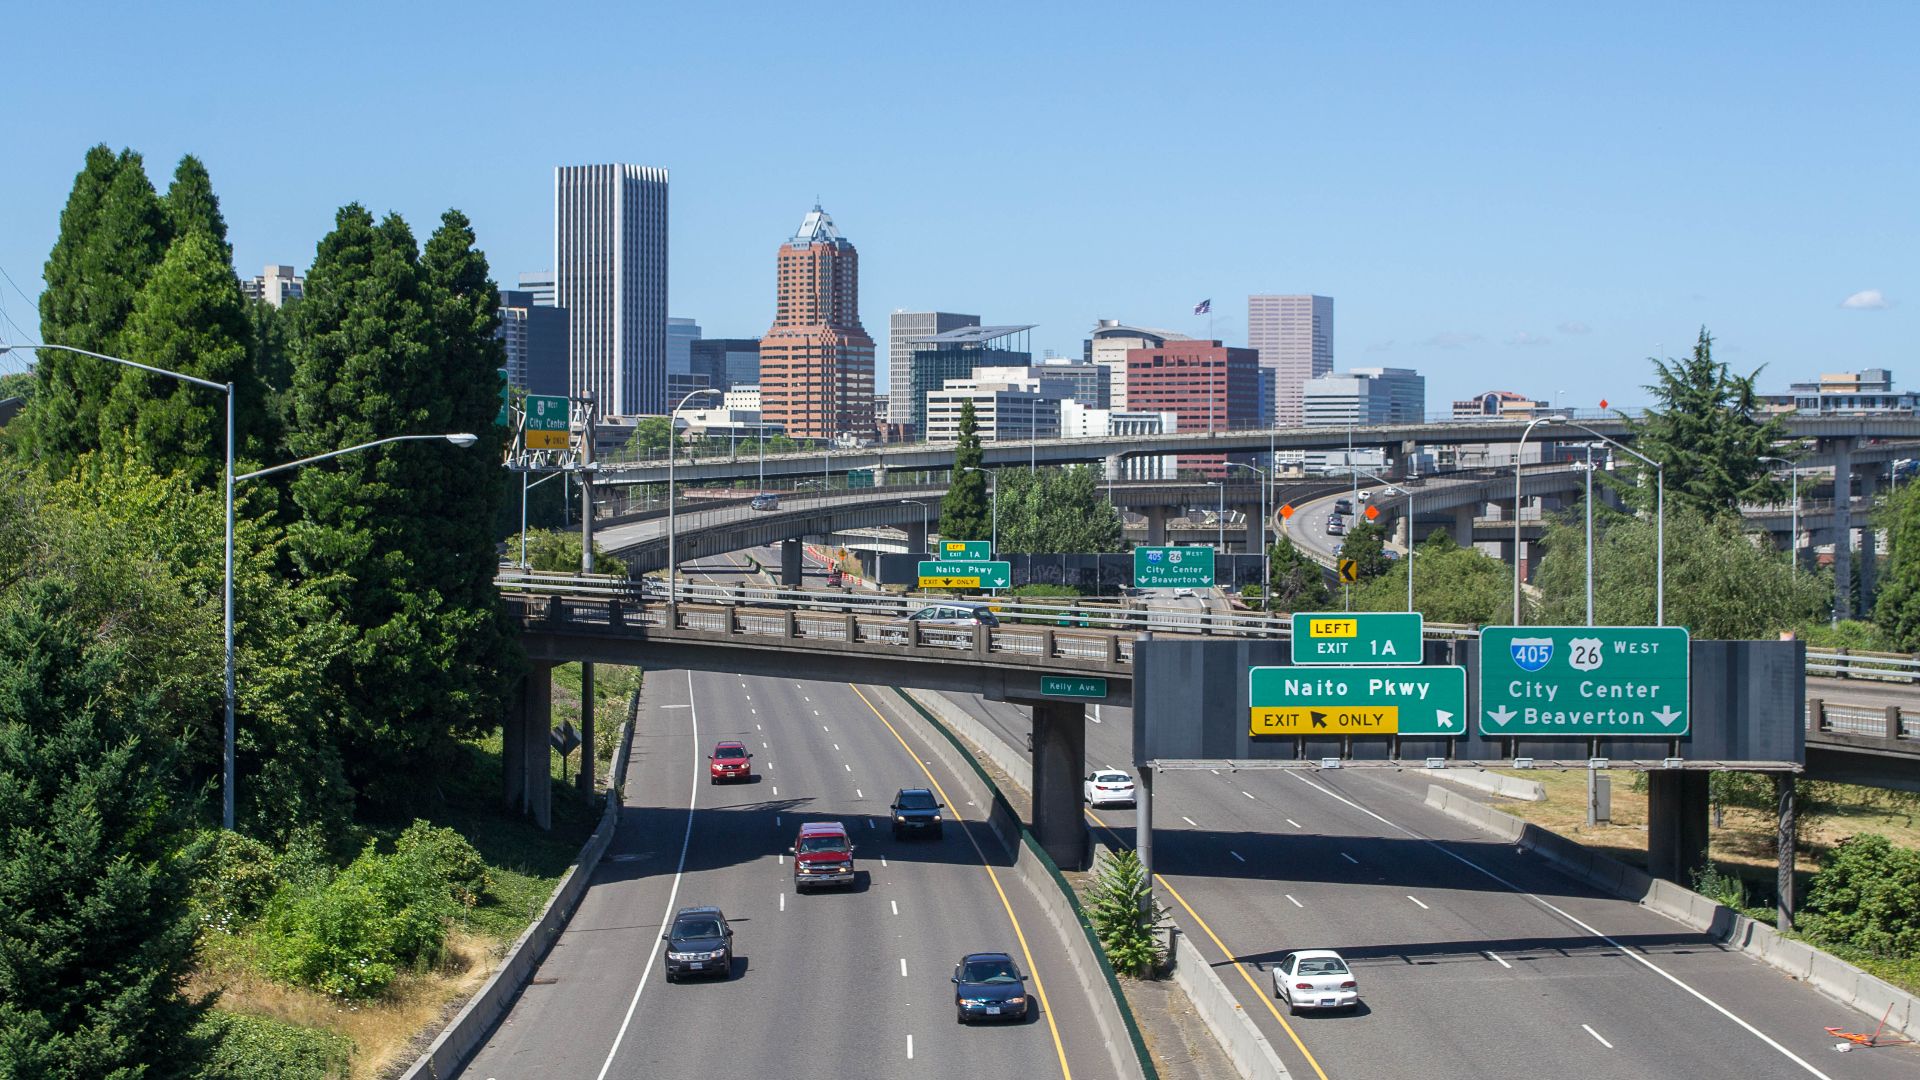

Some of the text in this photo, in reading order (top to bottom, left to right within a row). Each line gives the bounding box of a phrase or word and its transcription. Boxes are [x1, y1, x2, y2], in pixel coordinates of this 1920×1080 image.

[529, 417, 566, 429] City Center
[968, 566, 992, 575] Pkwy
[1146, 566, 1165, 574] City
[1315, 623, 1350, 634] LEFT
[1317, 639, 1397, 655] EXIT 1A
[1516, 641, 1660, 664] 405 26 WEST
[1049, 682, 1097, 691] Kelly Ave.
[1285, 679, 1430, 699] Naito Pkwy
[1508, 680, 1660, 702] City Center
[1264, 713, 1384, 726] EXIT ONLY
[1524, 708, 1645, 725] Beaverton
